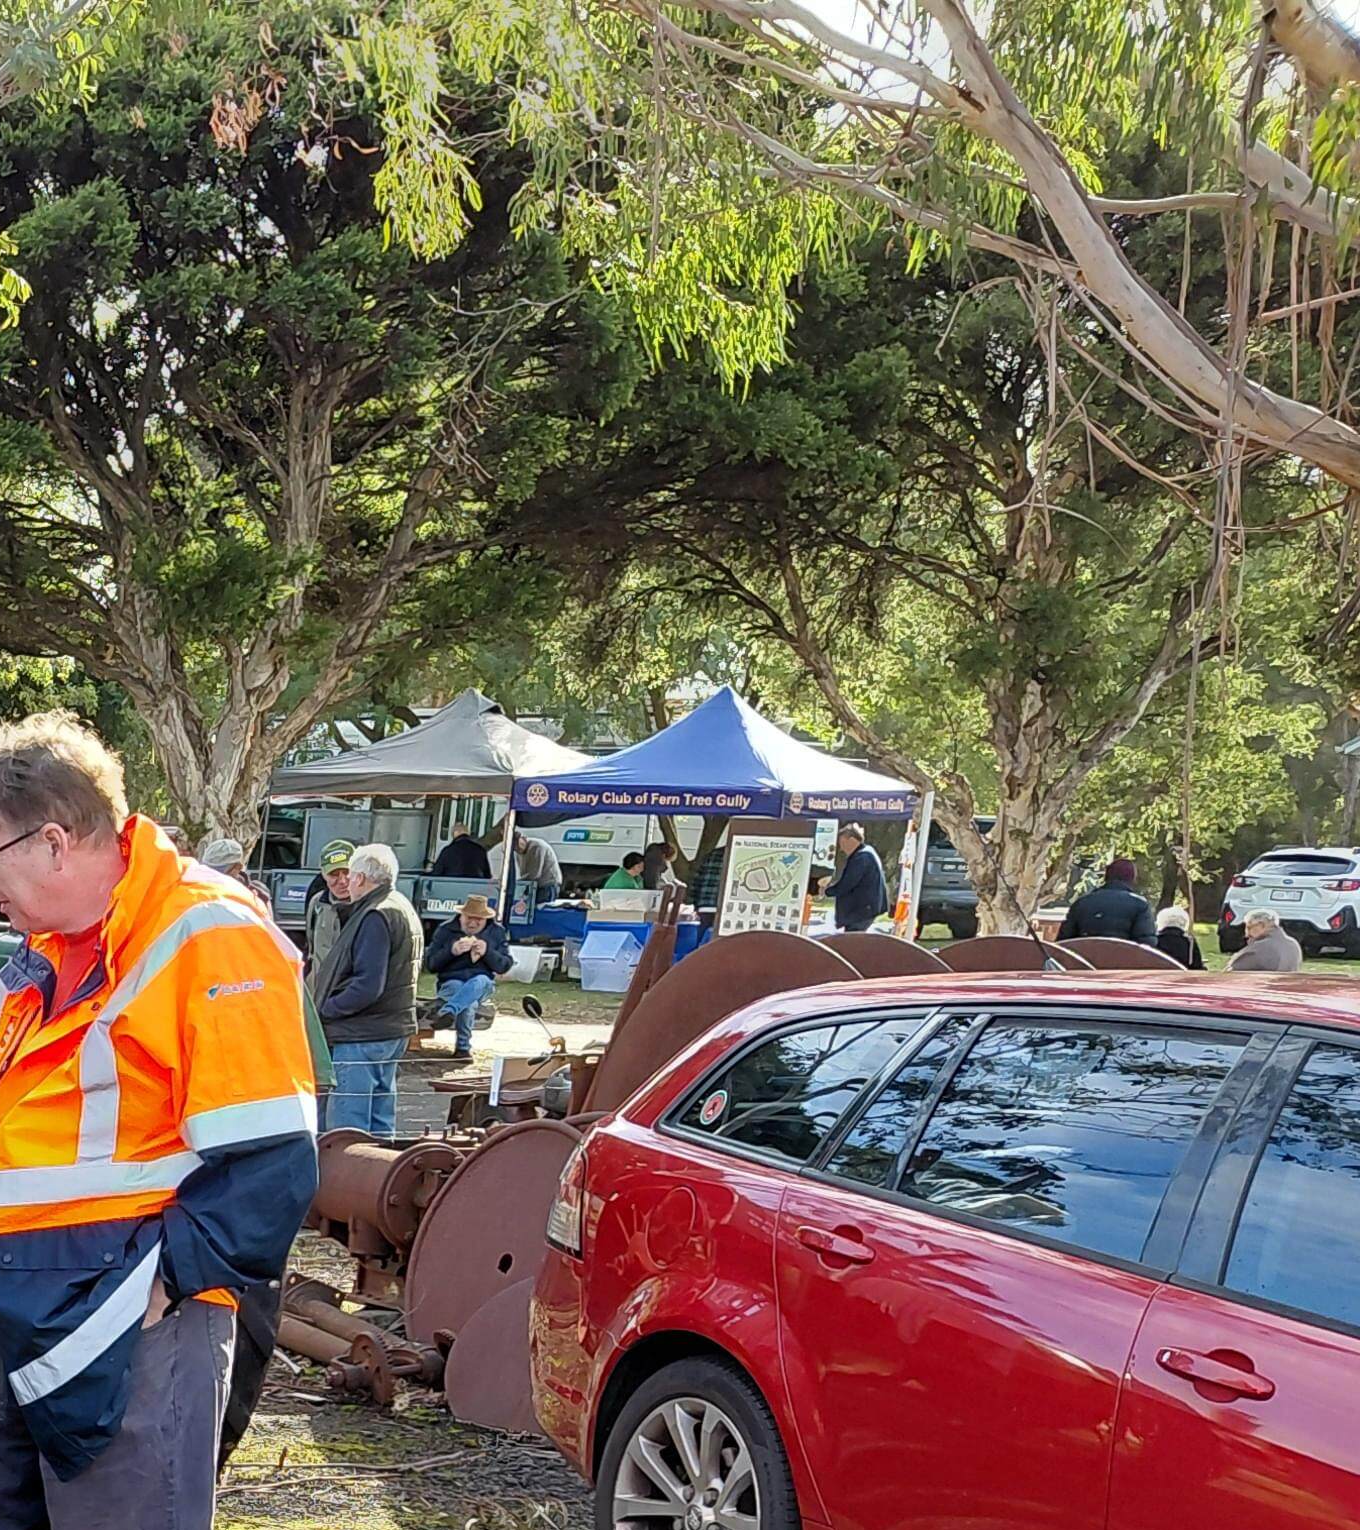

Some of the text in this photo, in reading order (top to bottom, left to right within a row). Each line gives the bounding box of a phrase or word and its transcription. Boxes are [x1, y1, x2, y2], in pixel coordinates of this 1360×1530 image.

[558, 790, 751, 810] Rotary Club of Fern Tree Gully
[808, 797, 831, 811] Rotary
[832, 797, 849, 809] Club
[849, 797, 857, 809] of
[857, 797, 872, 810] Fern
